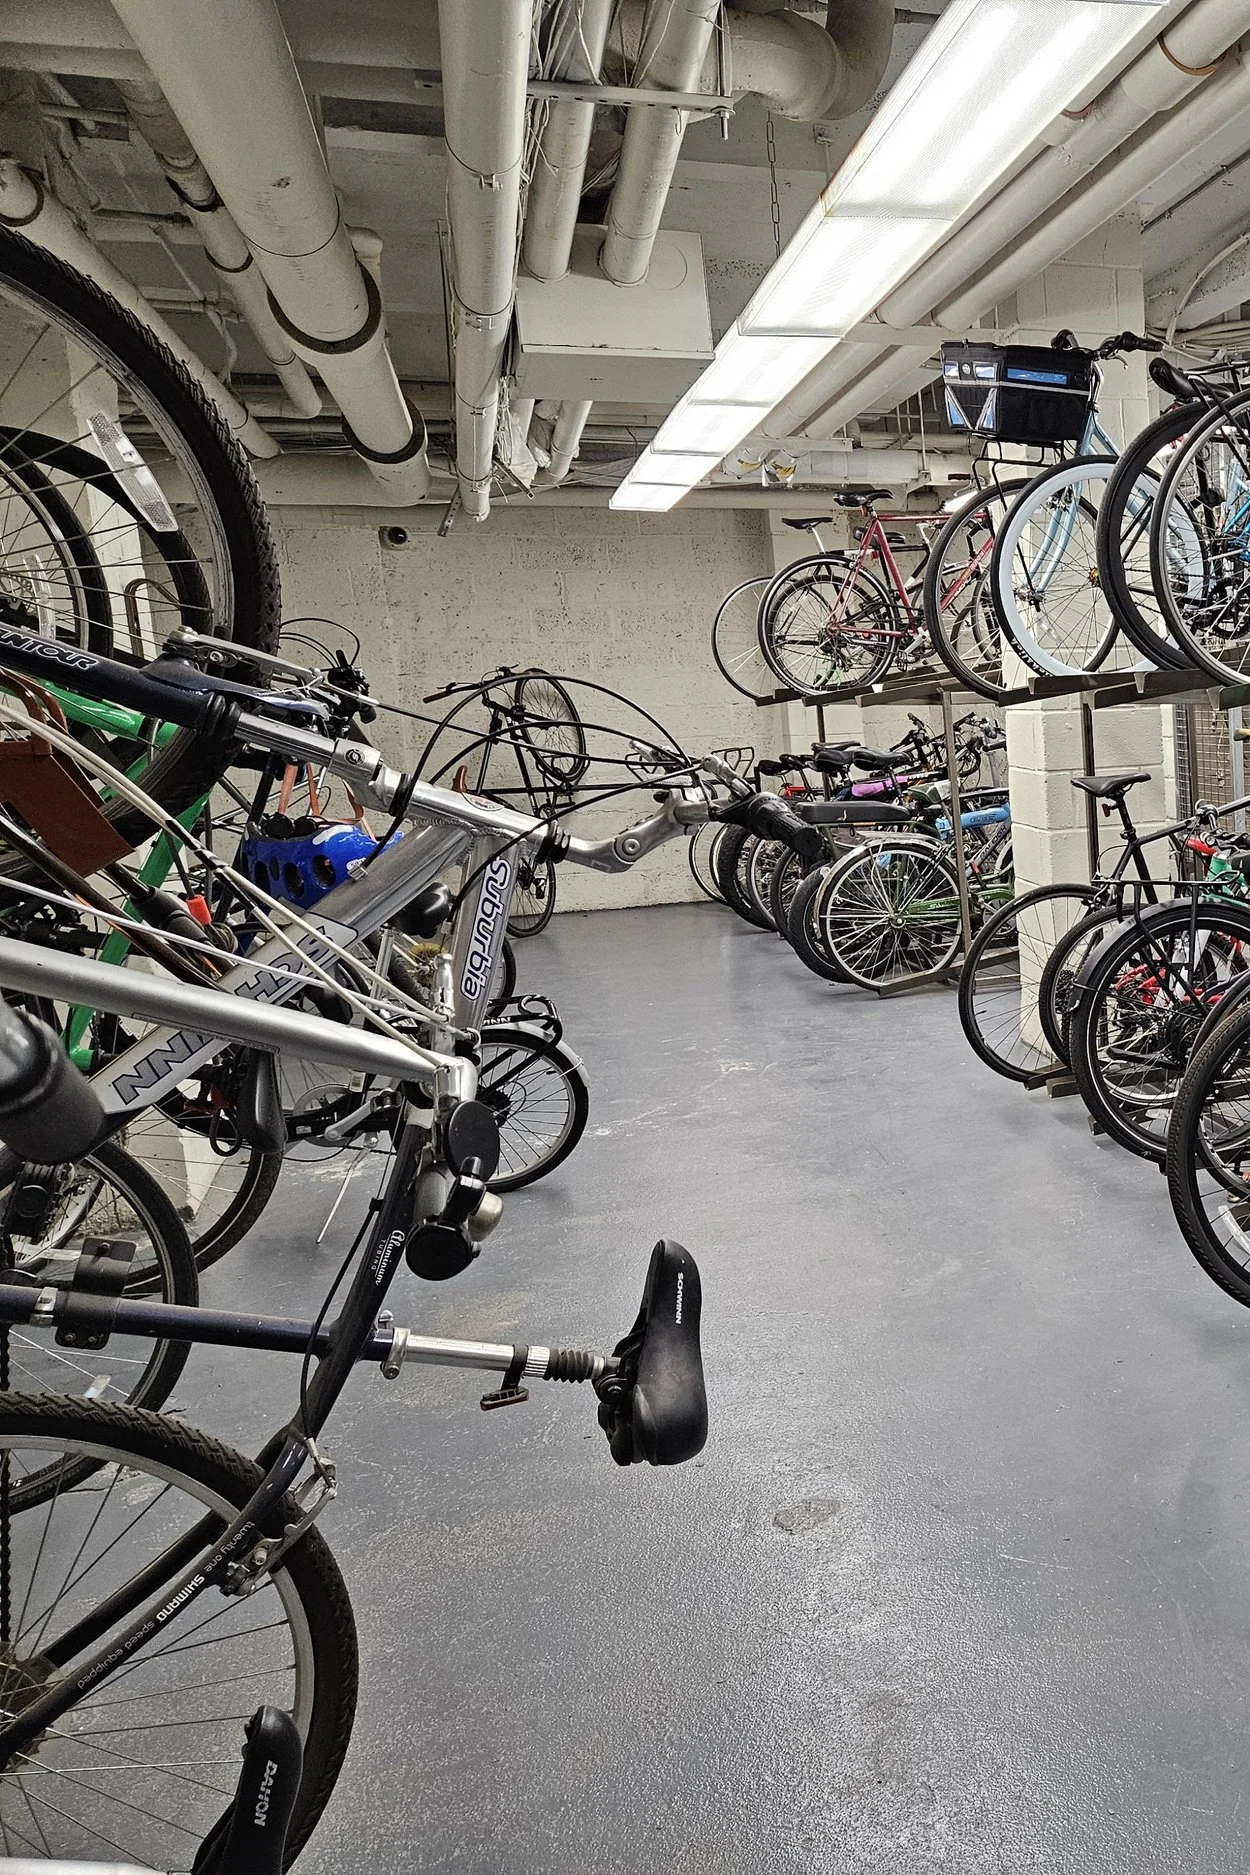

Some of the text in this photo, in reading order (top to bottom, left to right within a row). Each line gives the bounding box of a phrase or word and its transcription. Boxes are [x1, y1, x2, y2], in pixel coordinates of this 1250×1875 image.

[461, 857, 511, 1000] Suburbia
[375, 1230, 405, 1286] Aluminum
[675, 1272, 684, 1325] SCHWINN
[77, 1521, 256, 1690] twenty one SHIMANO speed equipped
[254, 1760, 278, 1827] DAHON
